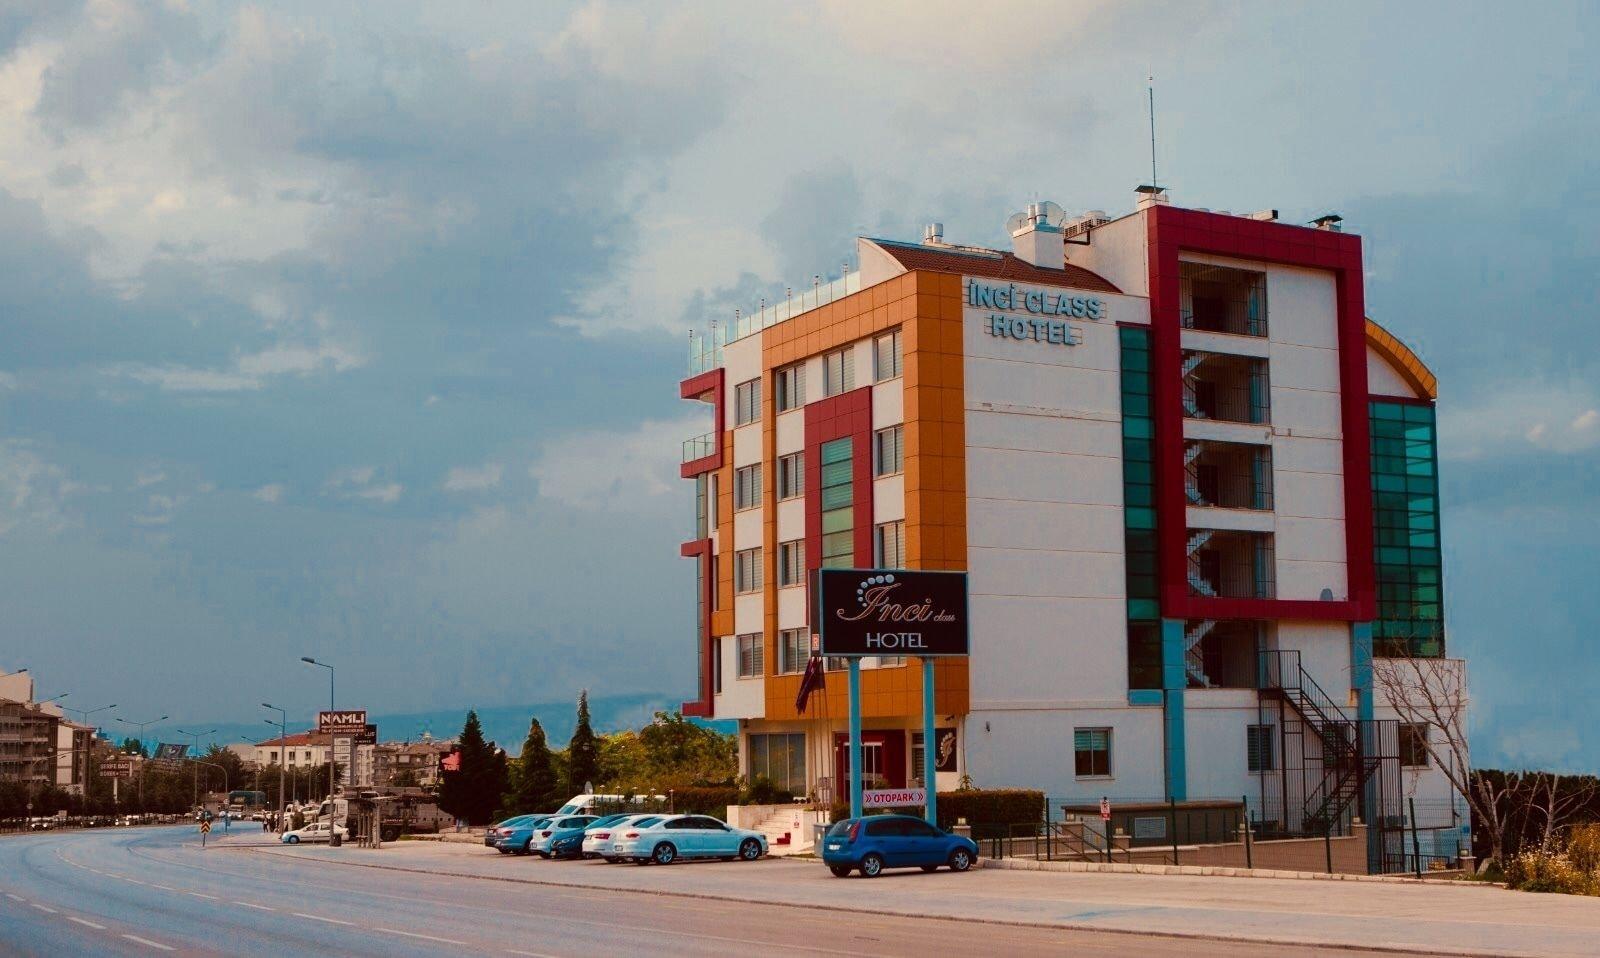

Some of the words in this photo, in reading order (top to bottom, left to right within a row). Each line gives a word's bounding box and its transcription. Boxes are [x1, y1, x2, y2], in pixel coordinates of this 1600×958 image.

[1025, 290, 1102, 320] CLASS
[991, 314, 1077, 346] HOTEL
[866, 632, 929, 649] HOTEL
[321, 713, 365, 724] NAMLI
[873, 793, 914, 803] OTOPARK
